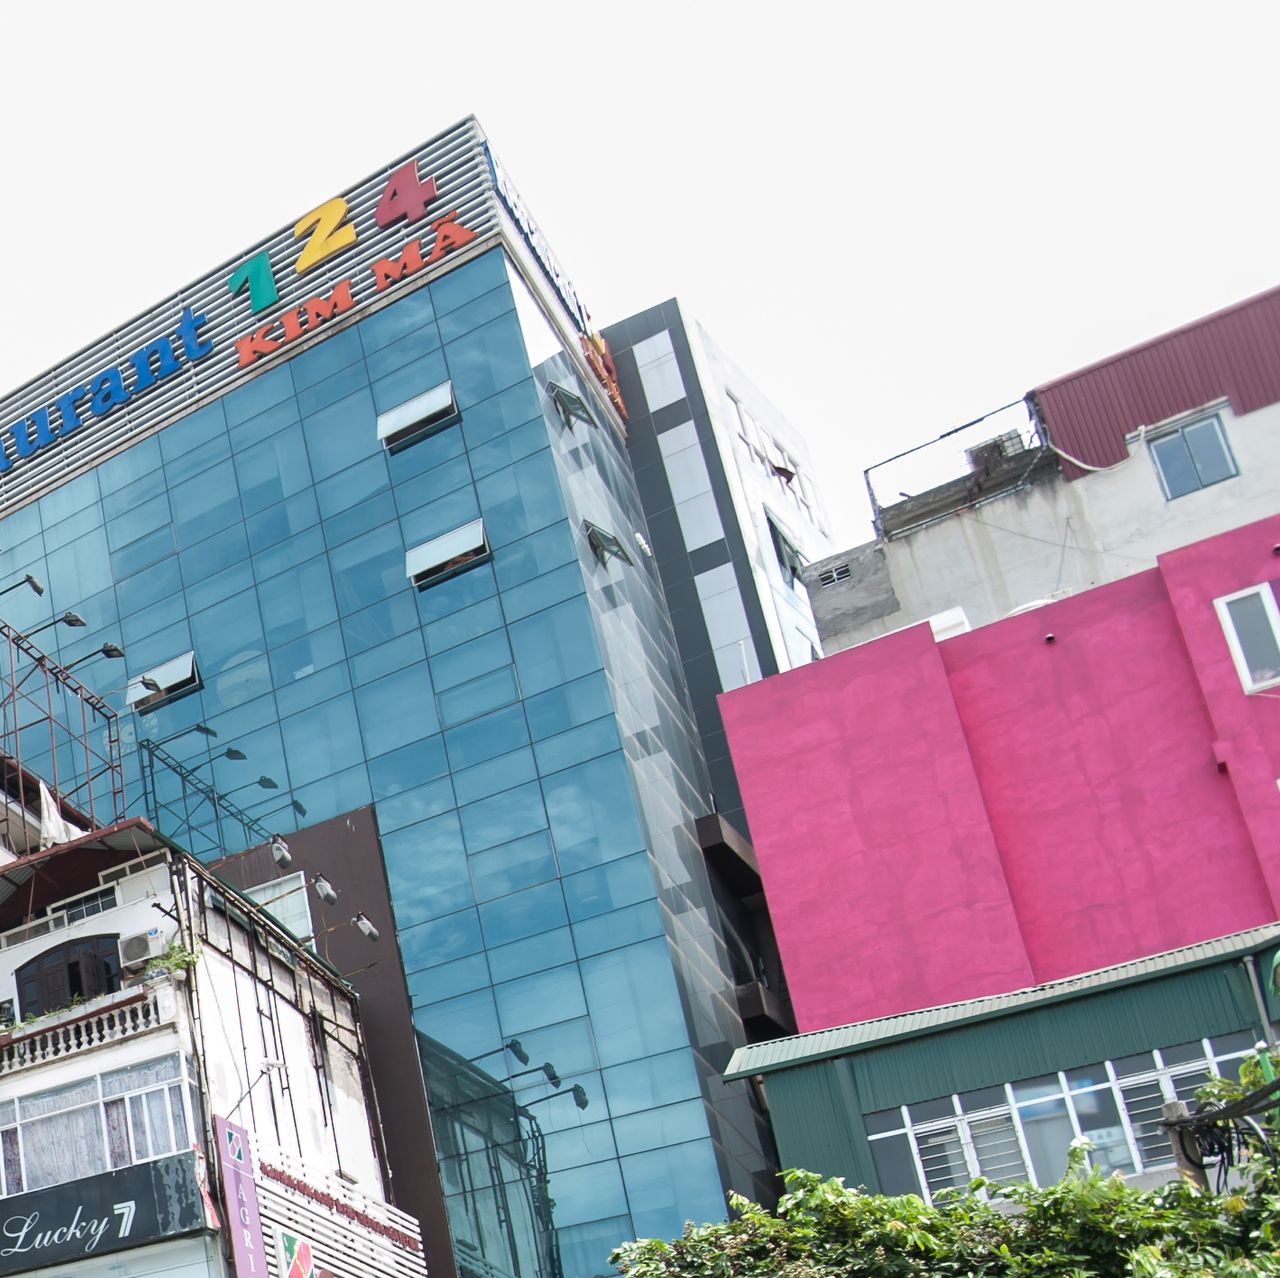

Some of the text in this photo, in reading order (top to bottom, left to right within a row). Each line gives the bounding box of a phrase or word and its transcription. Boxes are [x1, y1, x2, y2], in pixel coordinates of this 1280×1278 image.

[229, 160, 437, 313] 124
[235, 279, 358, 368] KIM
[370, 211, 480, 293] MÃ
[0, 1201, 135, 1257] Lucky 7
